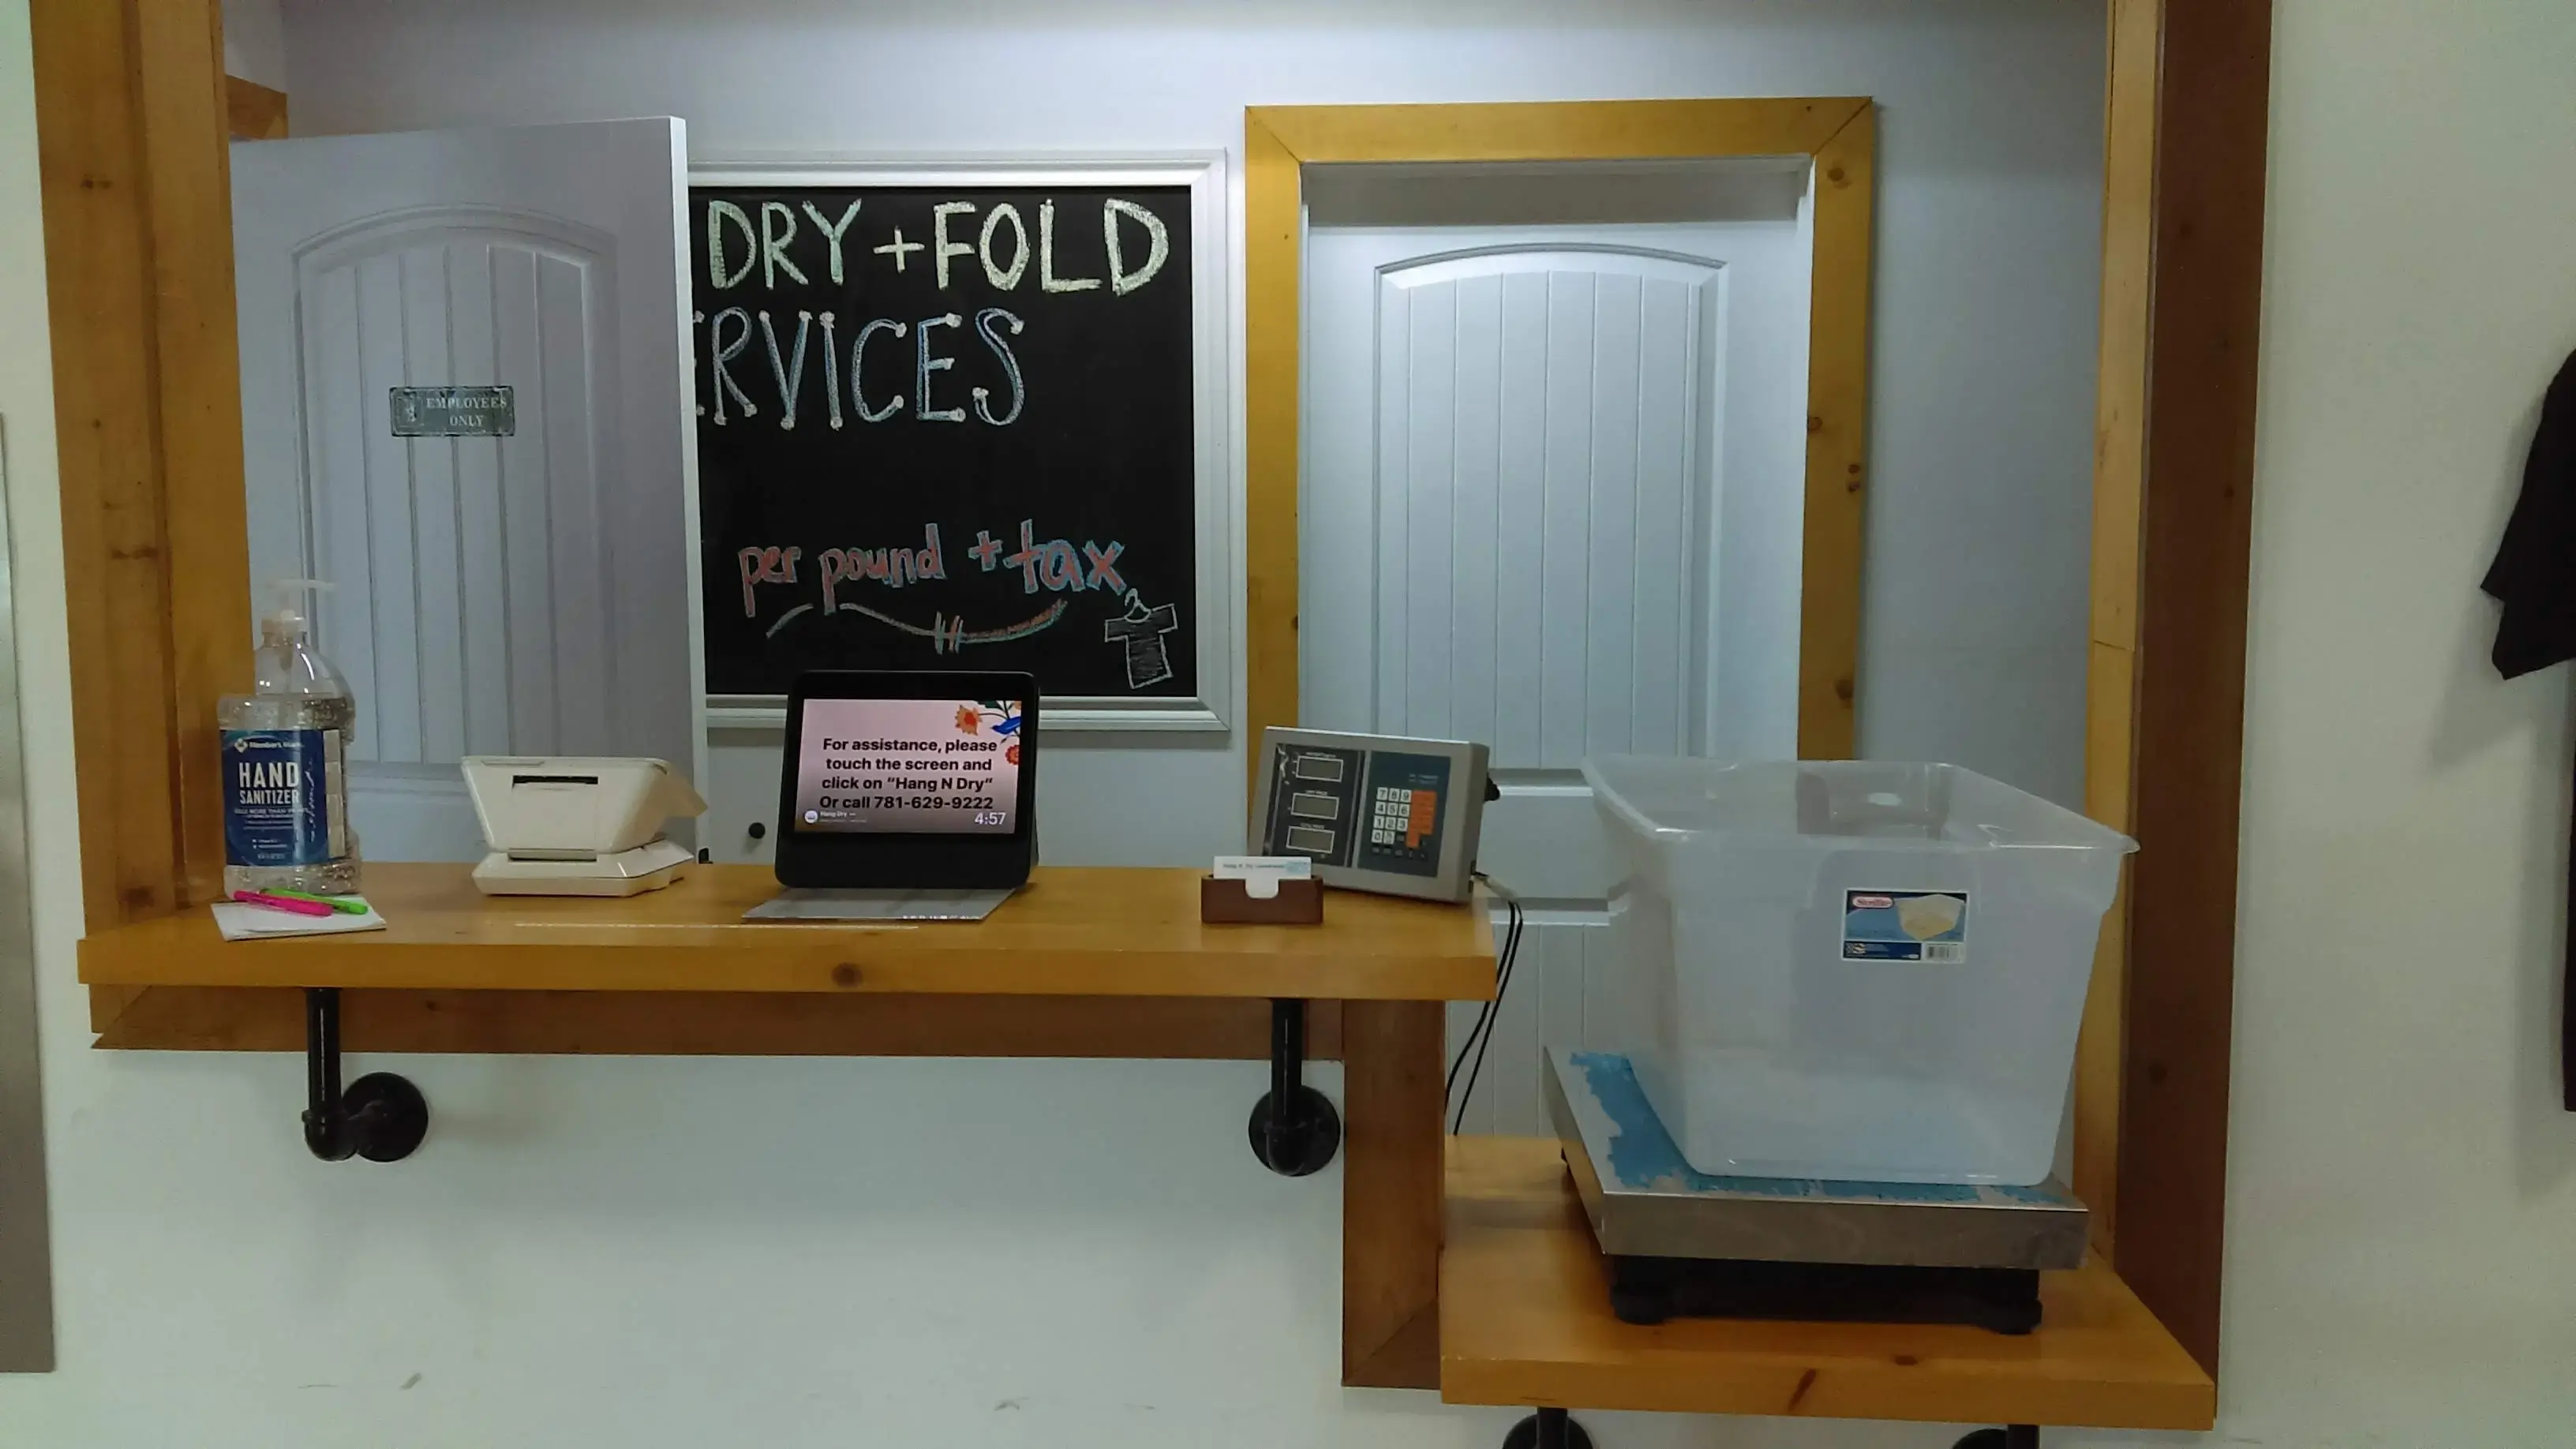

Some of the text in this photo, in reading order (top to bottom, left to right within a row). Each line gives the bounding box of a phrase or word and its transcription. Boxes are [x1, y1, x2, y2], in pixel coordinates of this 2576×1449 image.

[708, 197, 863, 290] DRY
[695, 306, 1026, 431] RVICES
[425, 396, 507, 409] EMPLOYEES
[448, 414, 485, 427] ONLY
[736, 544, 803, 618] per
[817, 522, 947, 616] pound
[822, 738, 998, 754] For assistance, please
[826, 758, 992, 771] touch the screen and
[238, 762, 300, 788] HAND
[822, 777, 859, 789] click
[863, 779, 883, 789] on
[941, 777, 953, 789] N
[239, 789, 301, 805] SANITIZER
[819, 796, 994, 809] Or call 781-629-9222
[974, 812, 1006, 826] 4:57
